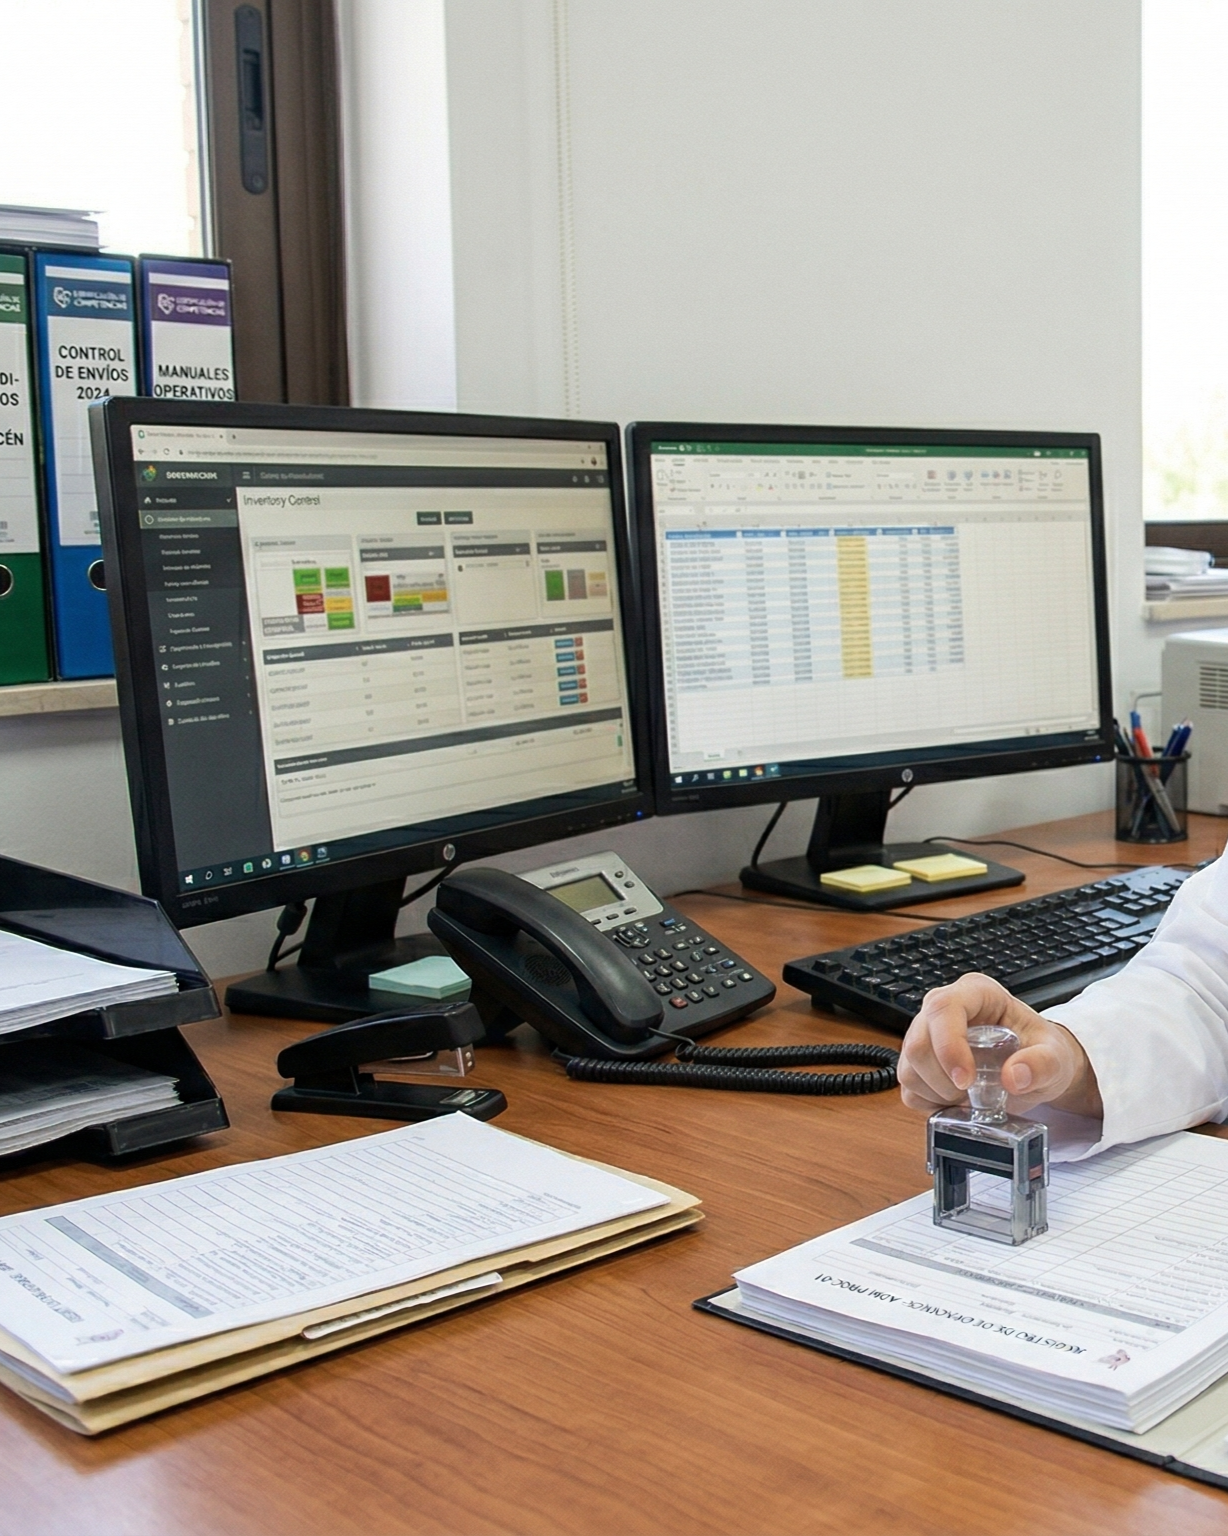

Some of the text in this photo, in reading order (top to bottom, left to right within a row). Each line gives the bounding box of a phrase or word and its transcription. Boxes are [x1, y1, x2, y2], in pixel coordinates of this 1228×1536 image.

[58, 345, 125, 362] CONTROL
[55, 363, 129, 382] DE ENVÍOS
[158, 364, 230, 381] MANUALES
[76, 386, 110, 400] 2024
[153, 384, 235, 400] OPERATIVOS
